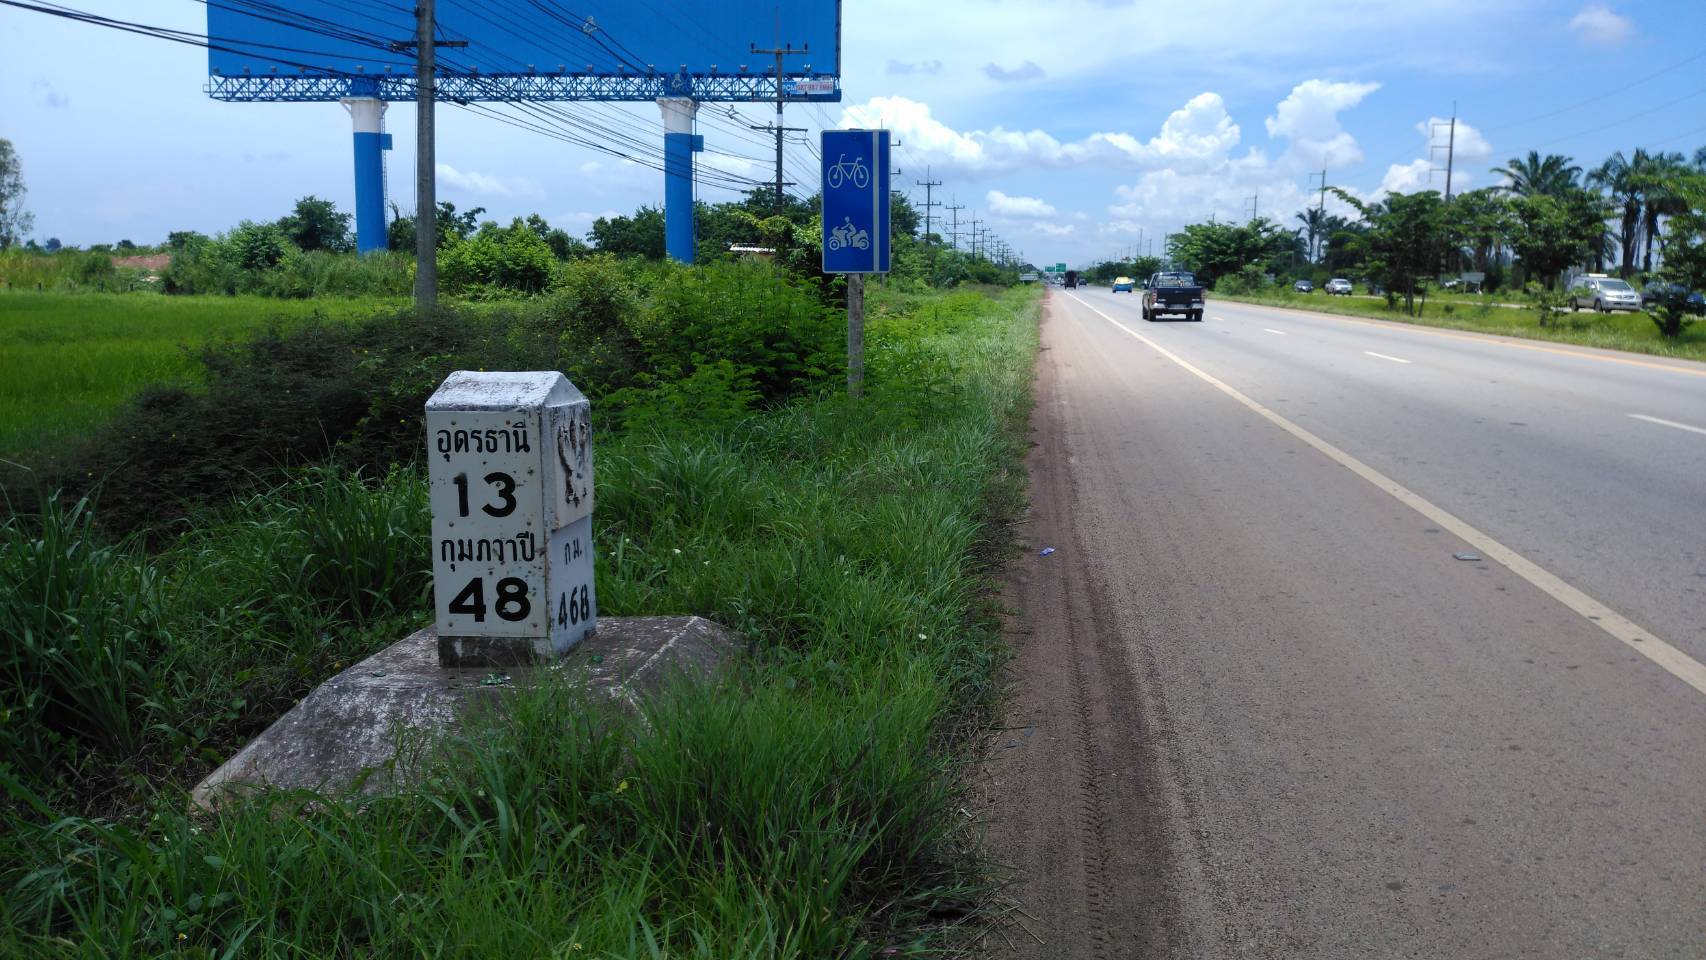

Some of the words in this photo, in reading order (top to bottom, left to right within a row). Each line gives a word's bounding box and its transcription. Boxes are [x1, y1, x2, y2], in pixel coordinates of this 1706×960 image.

[437, 421, 531, 462] อุดรธานี
[453, 471, 517, 518] 13
[441, 531, 535, 572] กุมภวาปี
[448, 577, 532, 622] 48
[558, 583, 590, 630] 468
